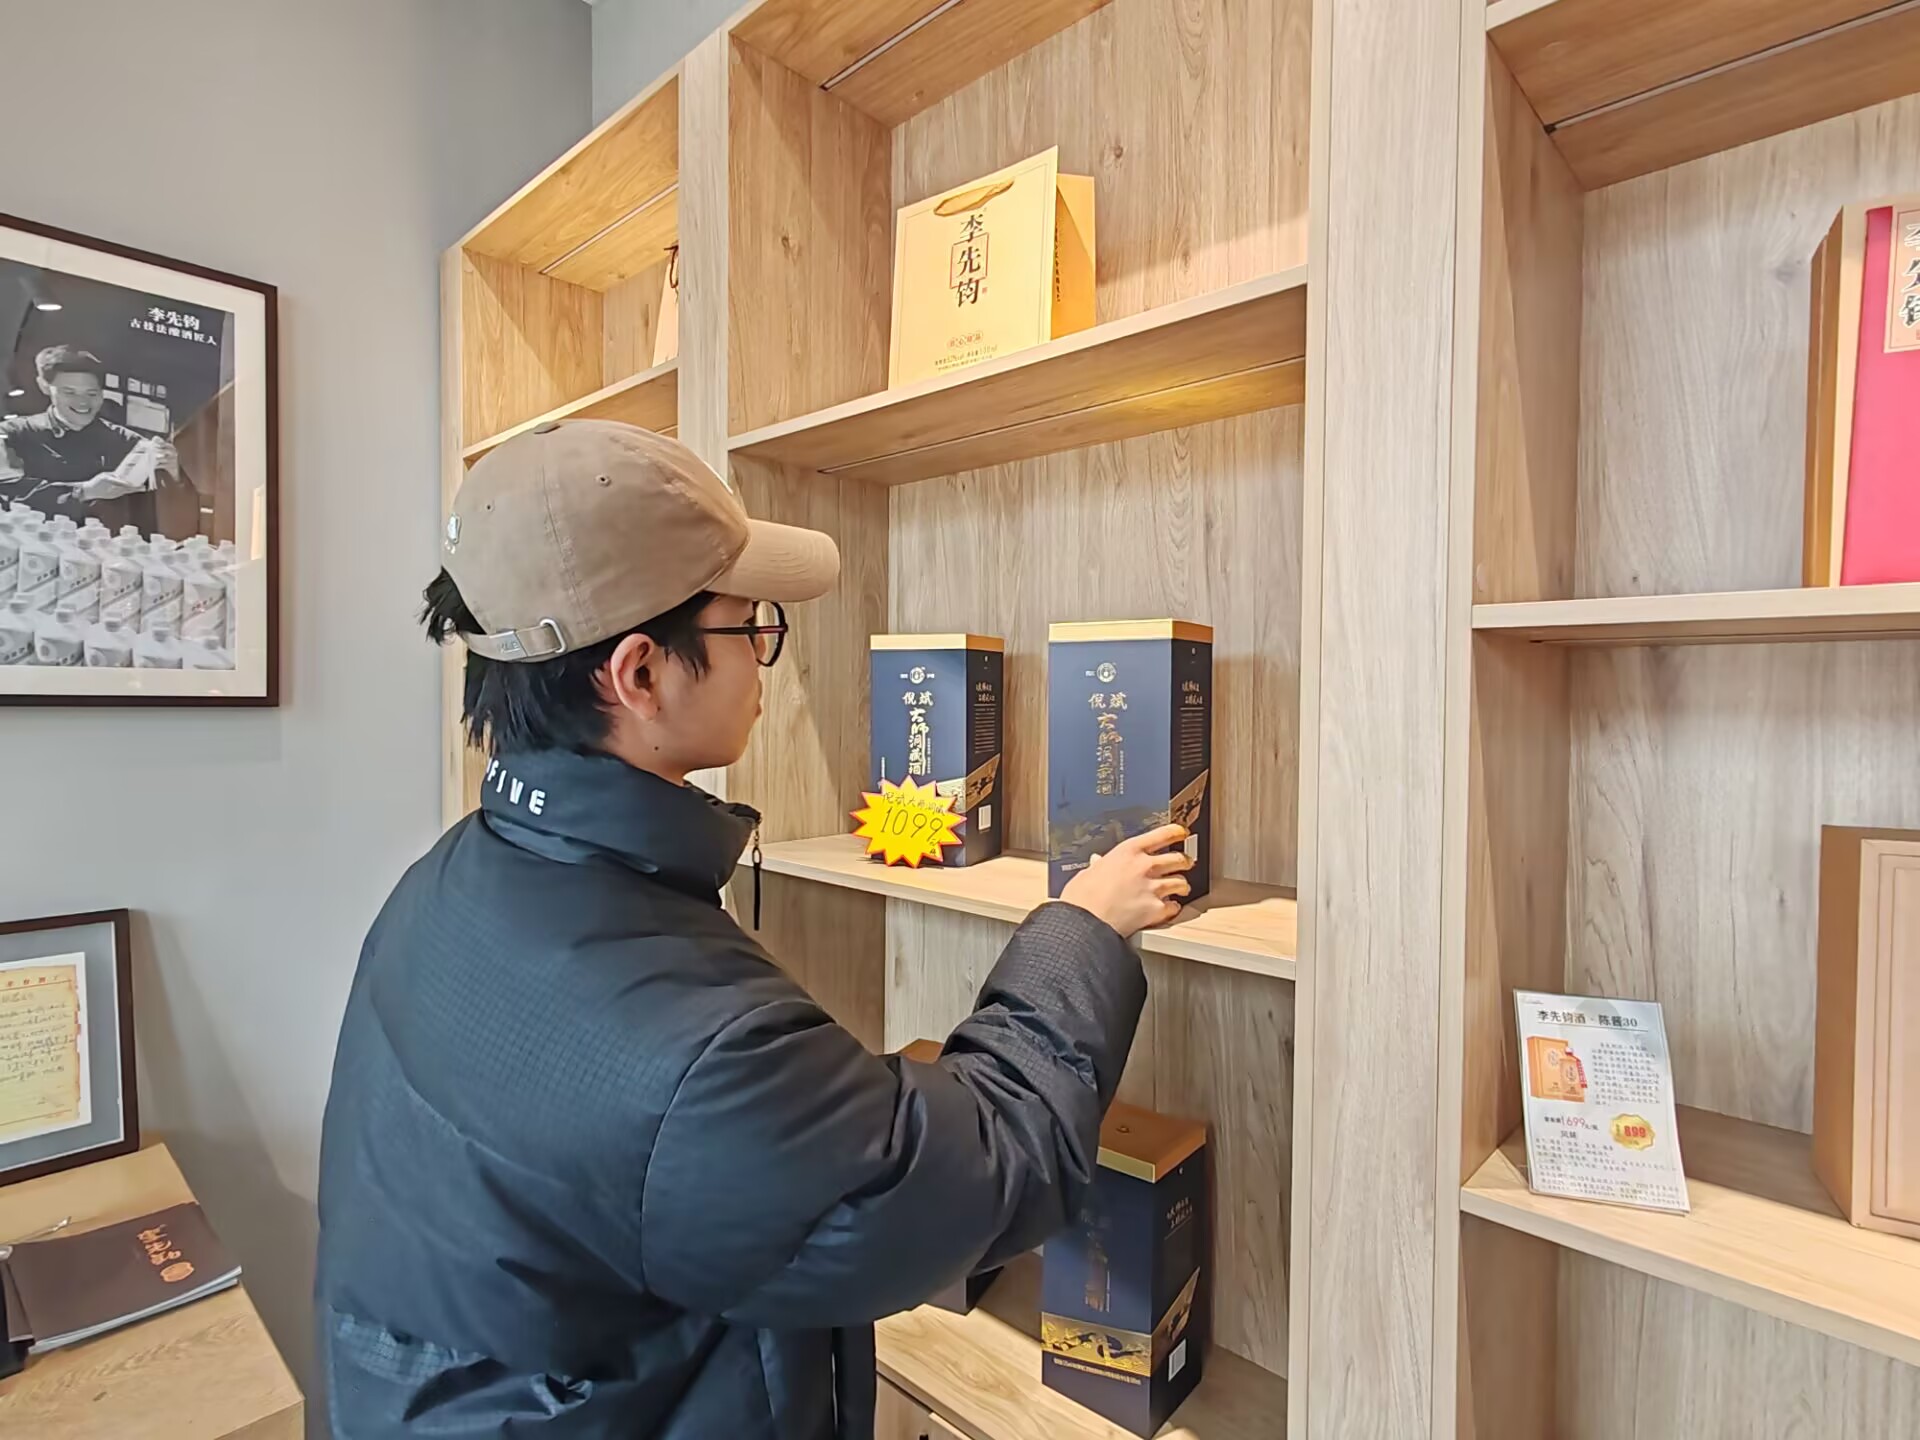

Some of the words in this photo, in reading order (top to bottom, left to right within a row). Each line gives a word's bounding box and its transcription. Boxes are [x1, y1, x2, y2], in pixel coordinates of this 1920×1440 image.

[957, 213, 984, 308] 李先钧
[147, 307, 201, 331] 李先钧
[486, 757, 547, 817] FIVE
[880, 806, 944, 843] 1099
